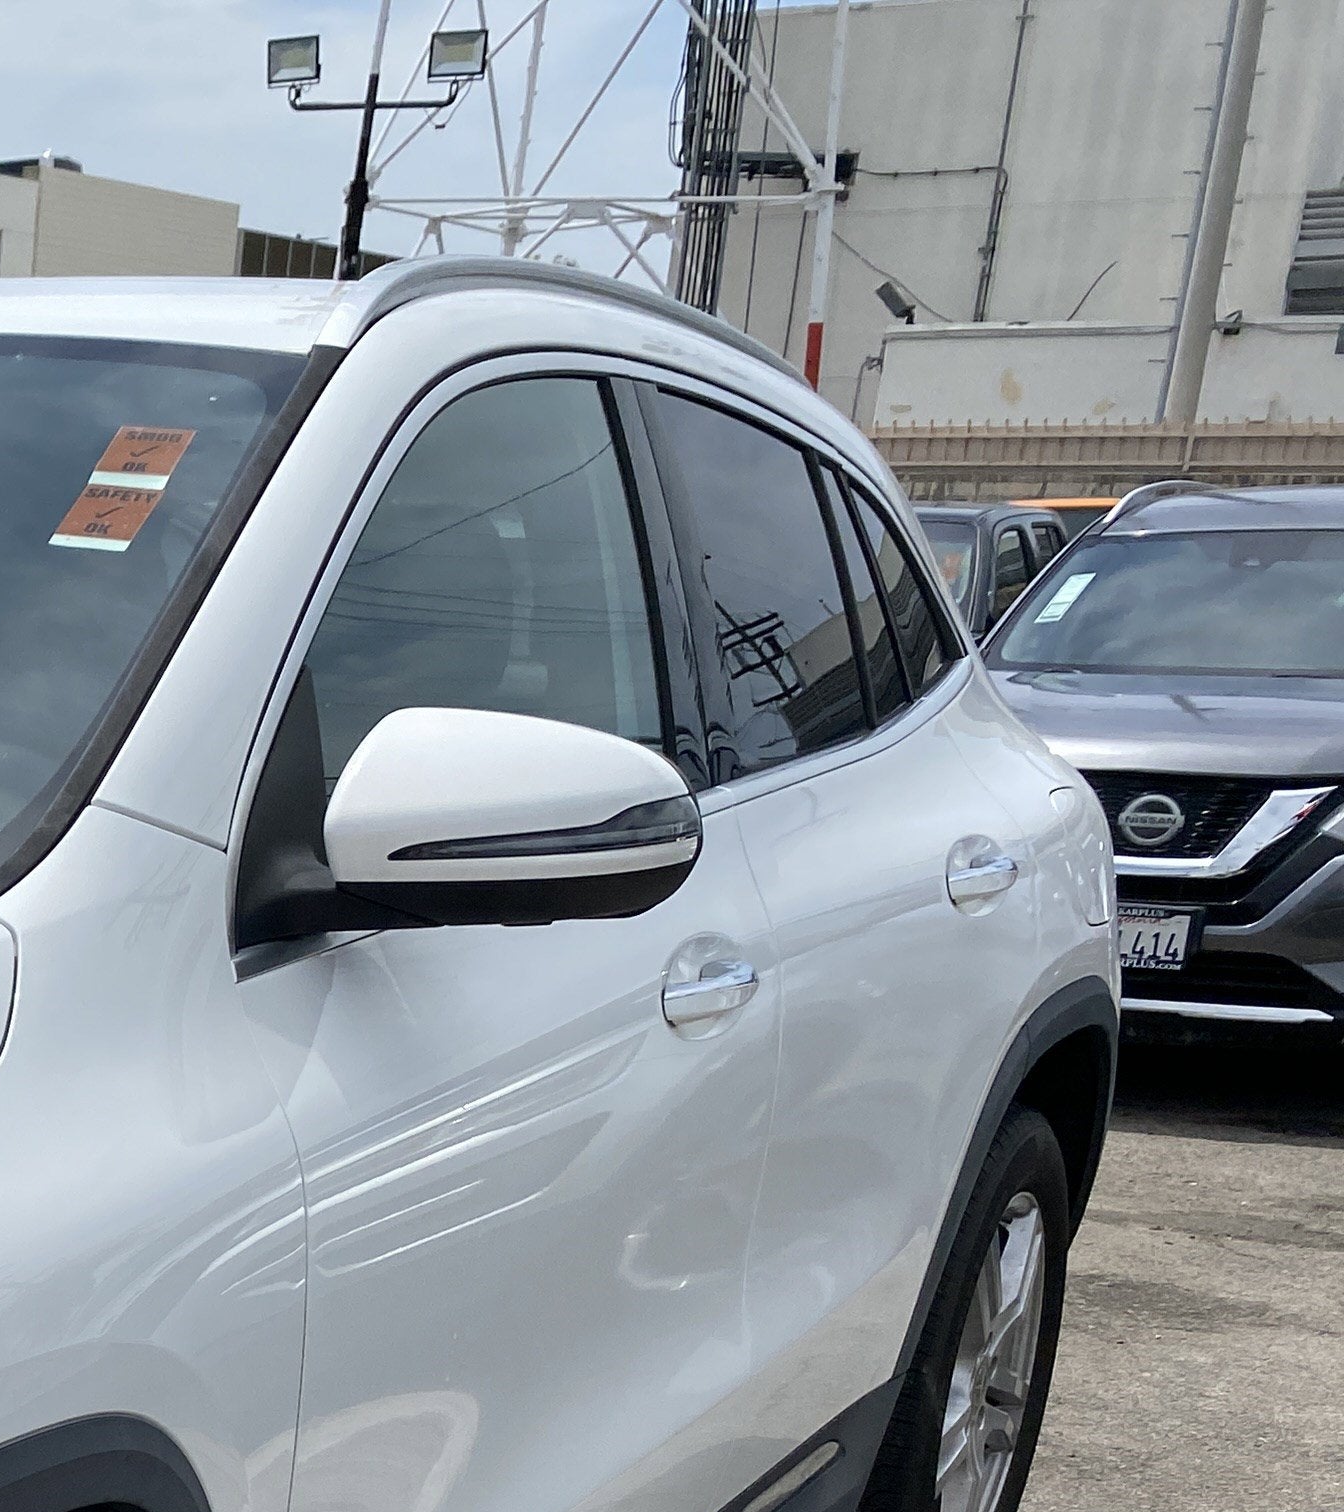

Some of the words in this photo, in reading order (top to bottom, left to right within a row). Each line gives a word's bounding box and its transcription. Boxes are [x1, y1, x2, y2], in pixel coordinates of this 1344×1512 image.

[122, 461, 148, 472] OK
[84, 488, 158, 503] SAFETY
[83, 522, 112, 535] OK
[1124, 815, 1178, 825] NISSAN
